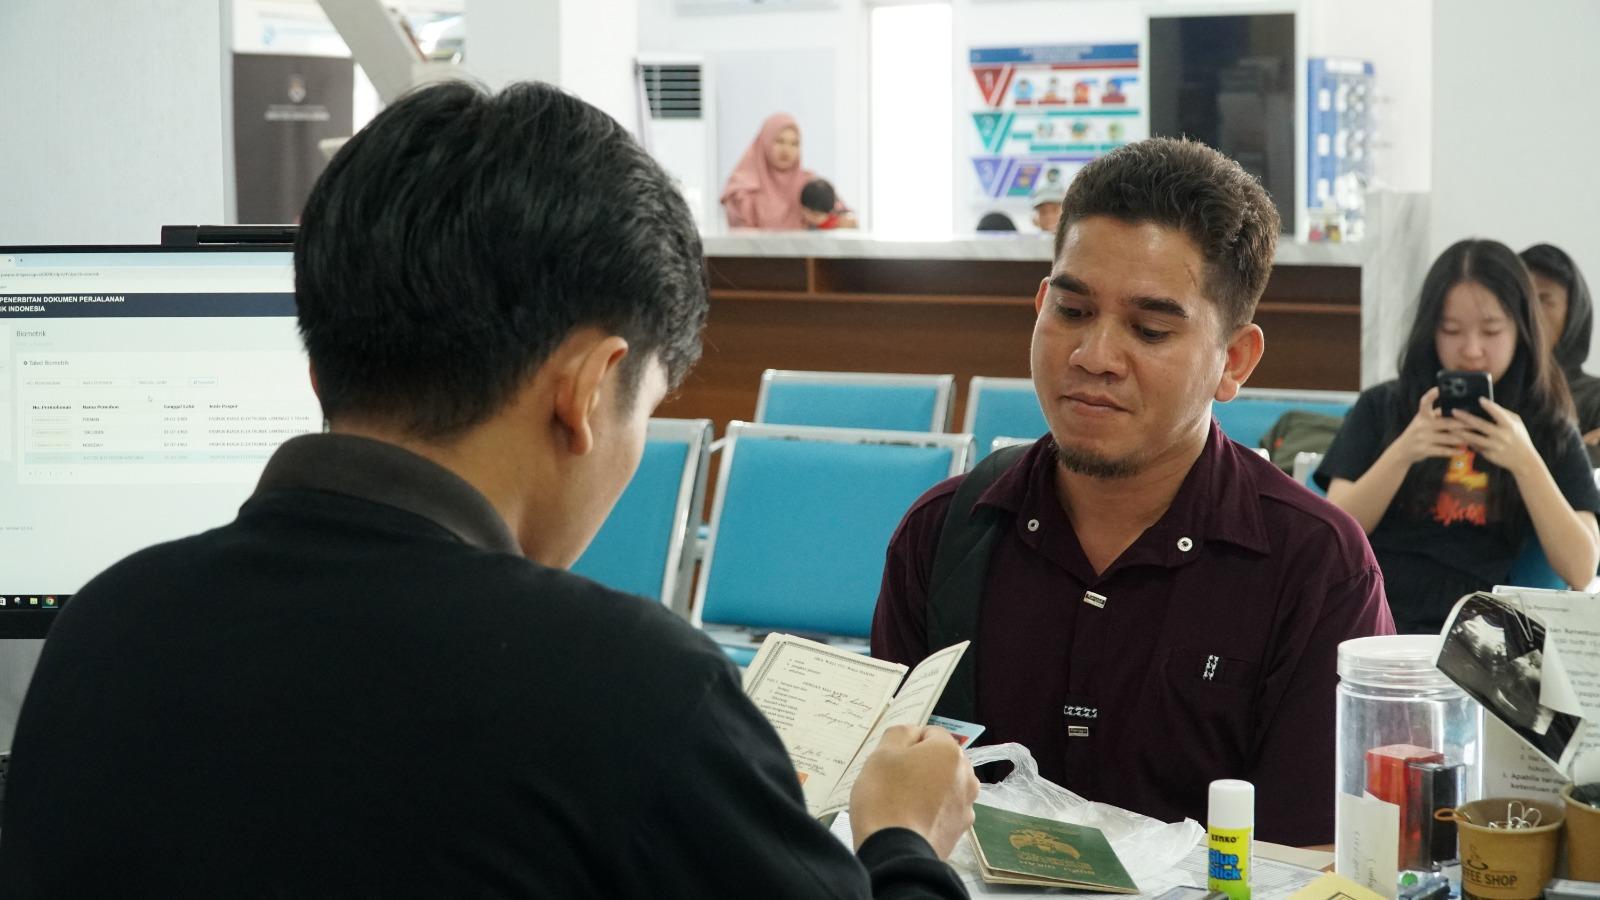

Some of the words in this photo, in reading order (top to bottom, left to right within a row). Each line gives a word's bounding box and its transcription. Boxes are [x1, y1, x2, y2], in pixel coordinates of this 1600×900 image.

[1208, 848, 1239, 866] Glue
[1208, 864, 1242, 881] Stick
[1484, 871, 1518, 886] SHOP
